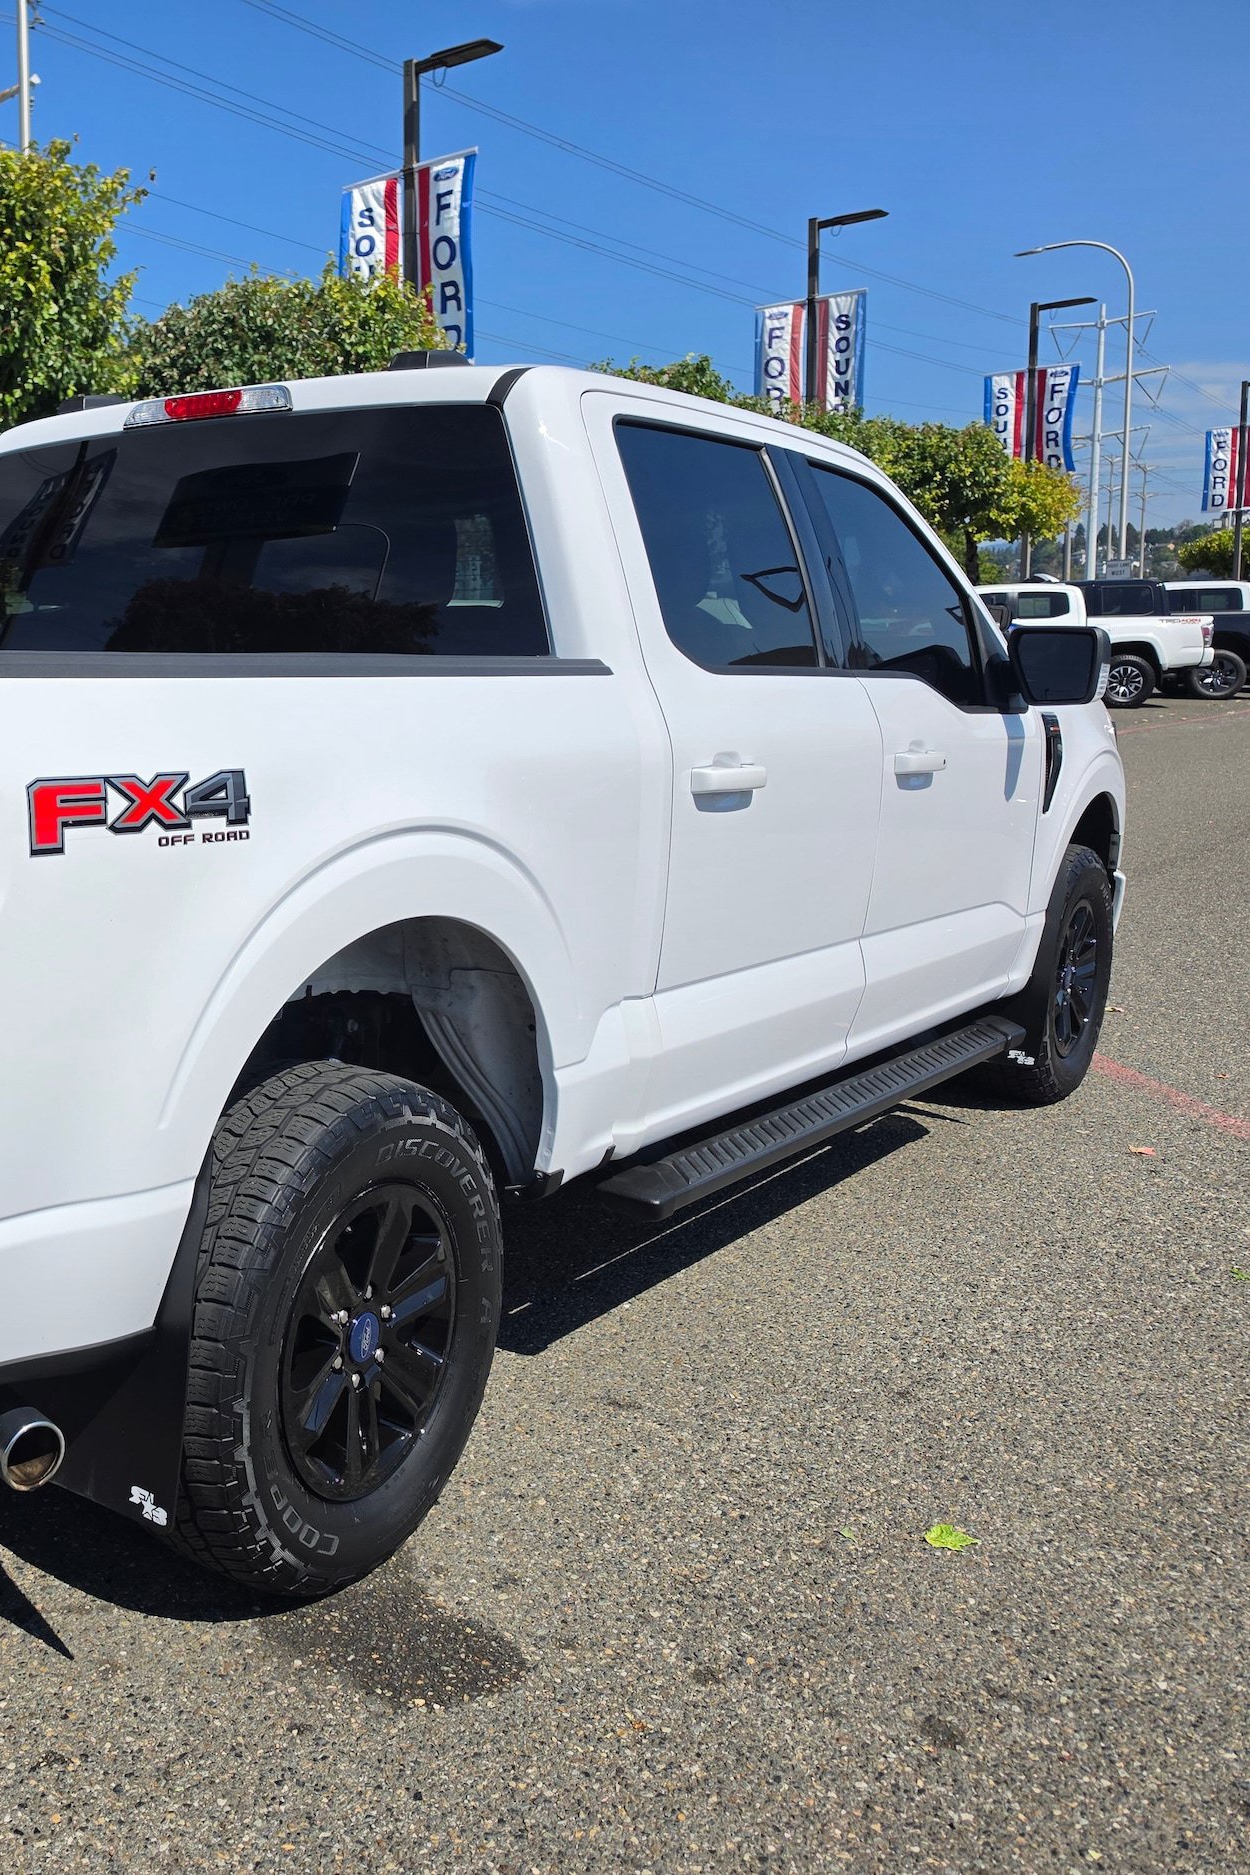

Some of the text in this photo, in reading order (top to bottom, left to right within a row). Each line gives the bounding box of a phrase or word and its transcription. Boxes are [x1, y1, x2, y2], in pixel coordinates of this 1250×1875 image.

[1046, 382, 1065, 469] FORD
[1212, 440, 1227, 508] FORD
[26, 768, 251, 858] FX4
[158, 830, 250, 847] OFF ROAD
[374, 1137, 494, 1273] DISCOVERER
